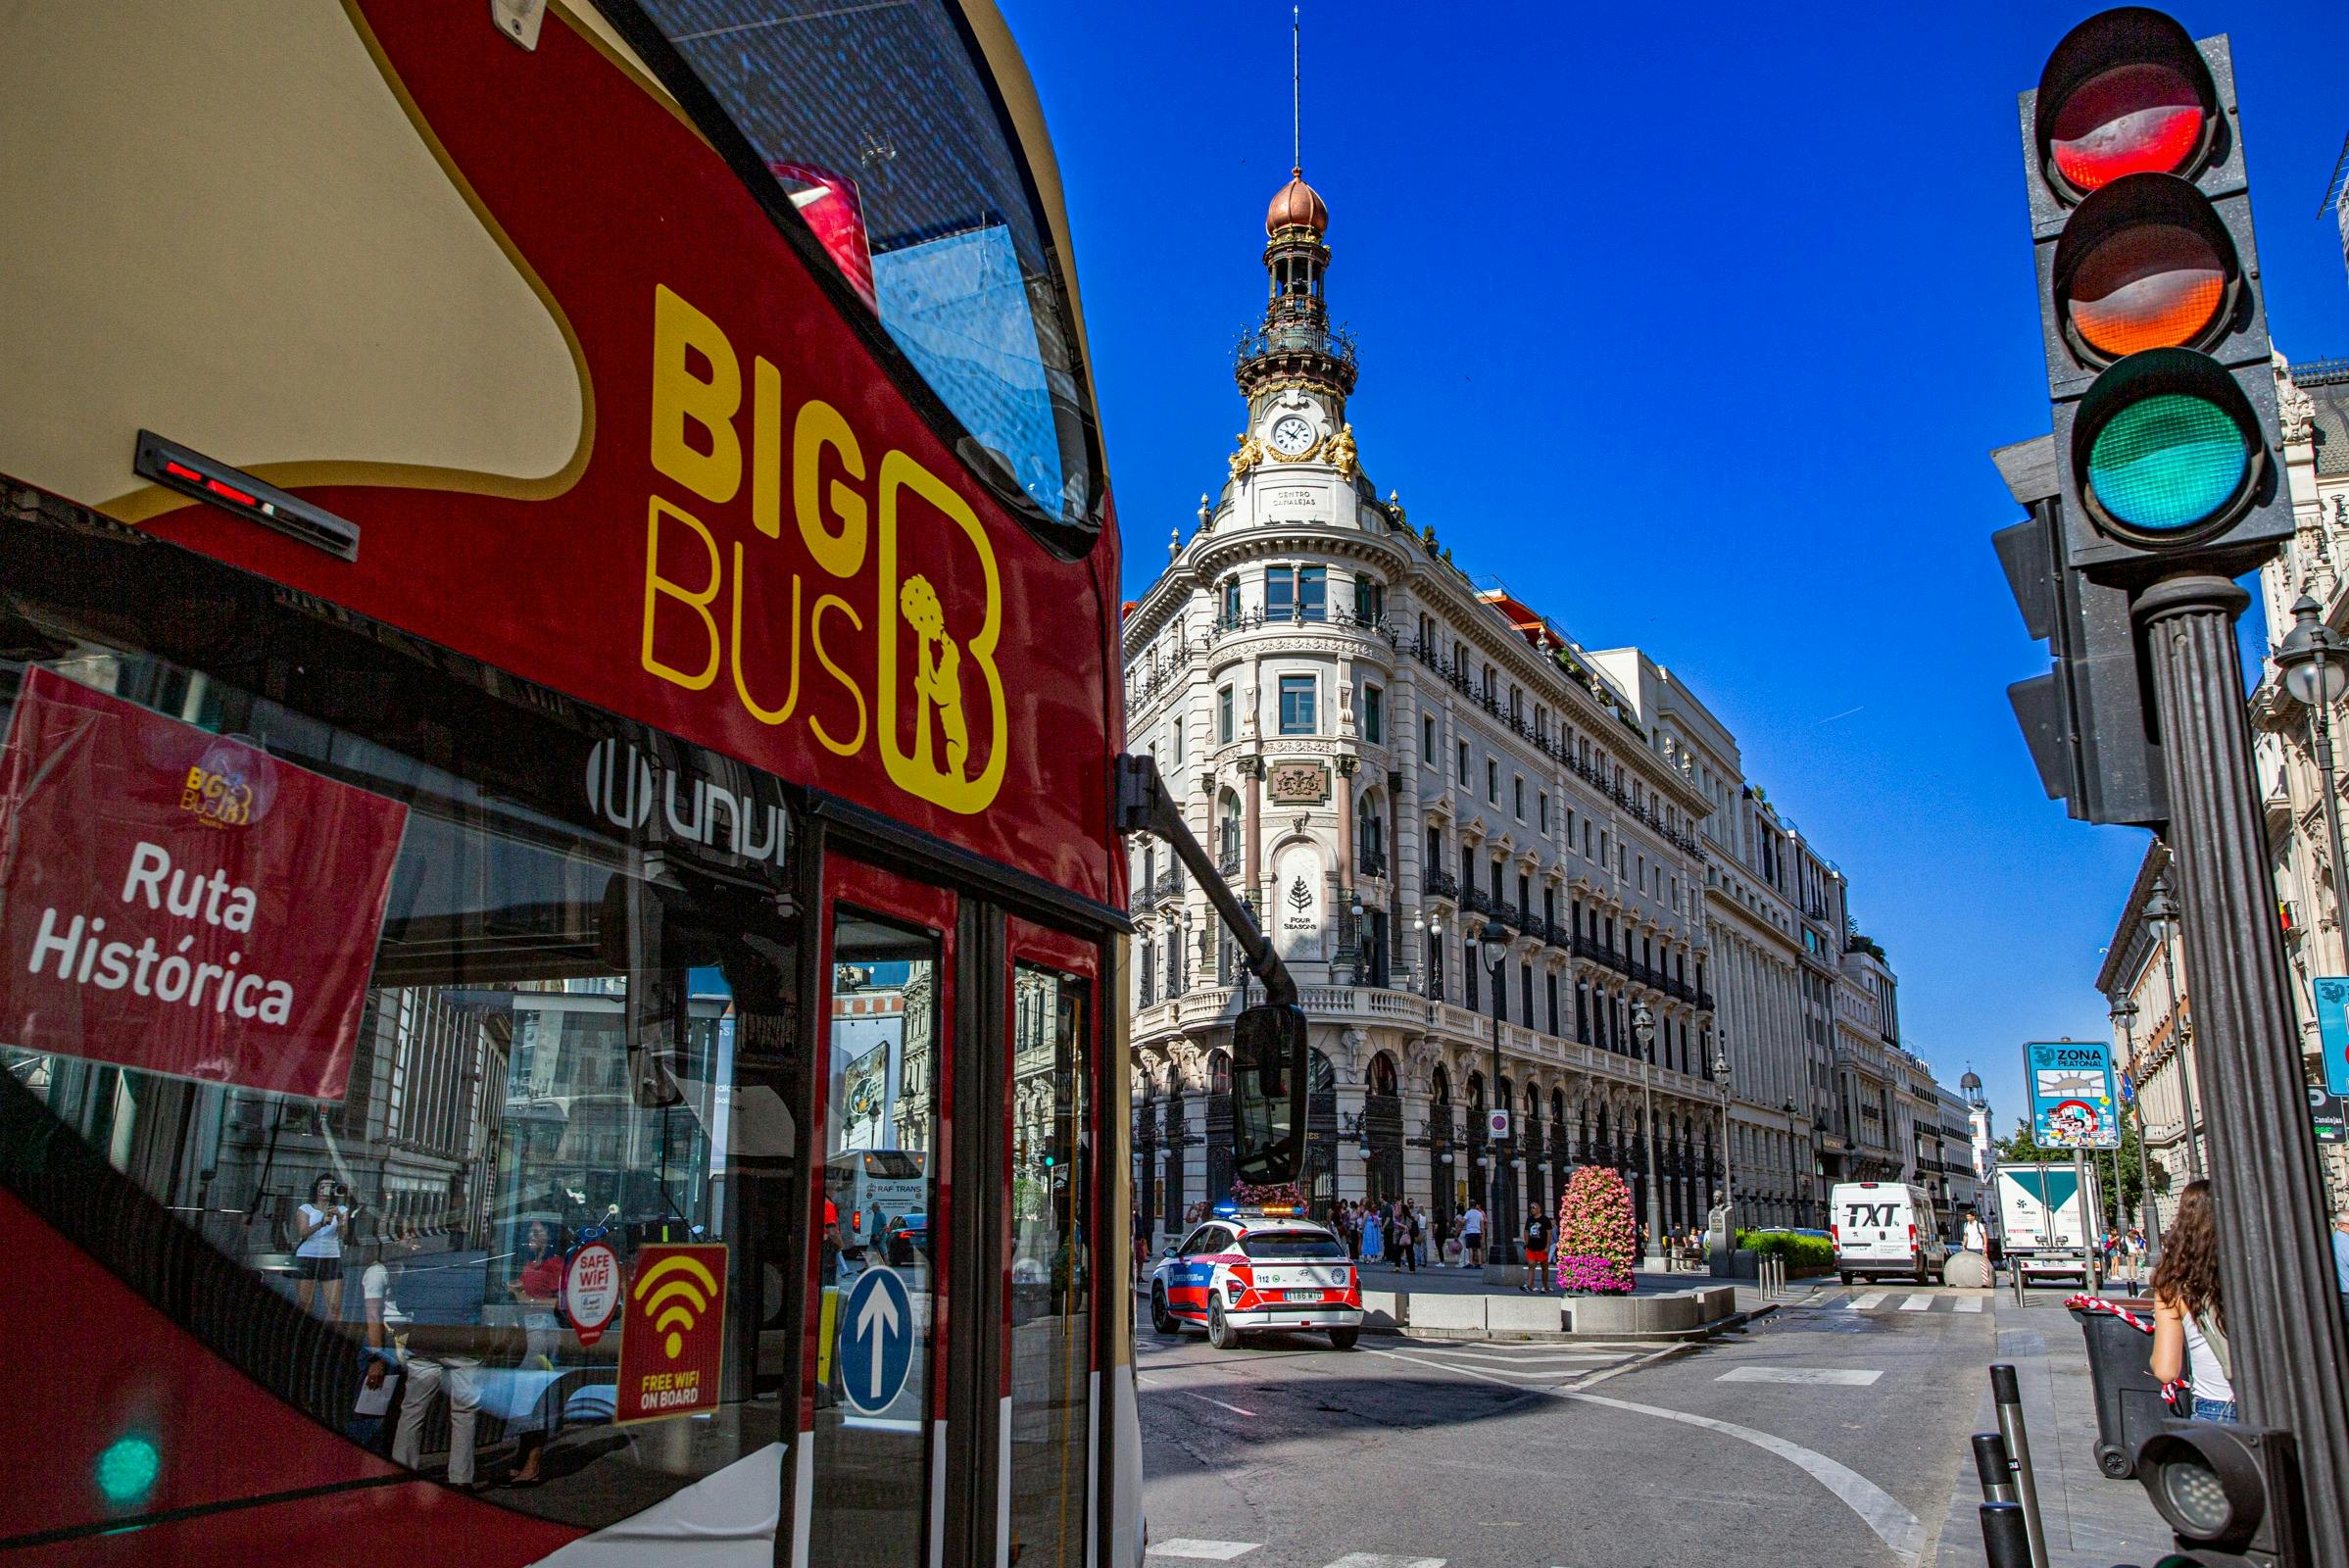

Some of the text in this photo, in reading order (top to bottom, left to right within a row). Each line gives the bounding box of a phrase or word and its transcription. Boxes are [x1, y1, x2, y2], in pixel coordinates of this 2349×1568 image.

[651, 283, 867, 578] BIG
[642, 494, 867, 757] BUS
[122, 841, 257, 934] Ruta
[28, 908, 294, 1026] Histórica
[2057, 1050, 2102, 1060] ZONA
[2314, 1116, 2343, 1125] Canalejas
[1845, 1203, 1901, 1228] TXT
[580, 1254, 610, 1269] SAFE
[642, 1370, 700, 1392] FREE WIFI
[640, 1388, 699, 1410] ON BOARD
